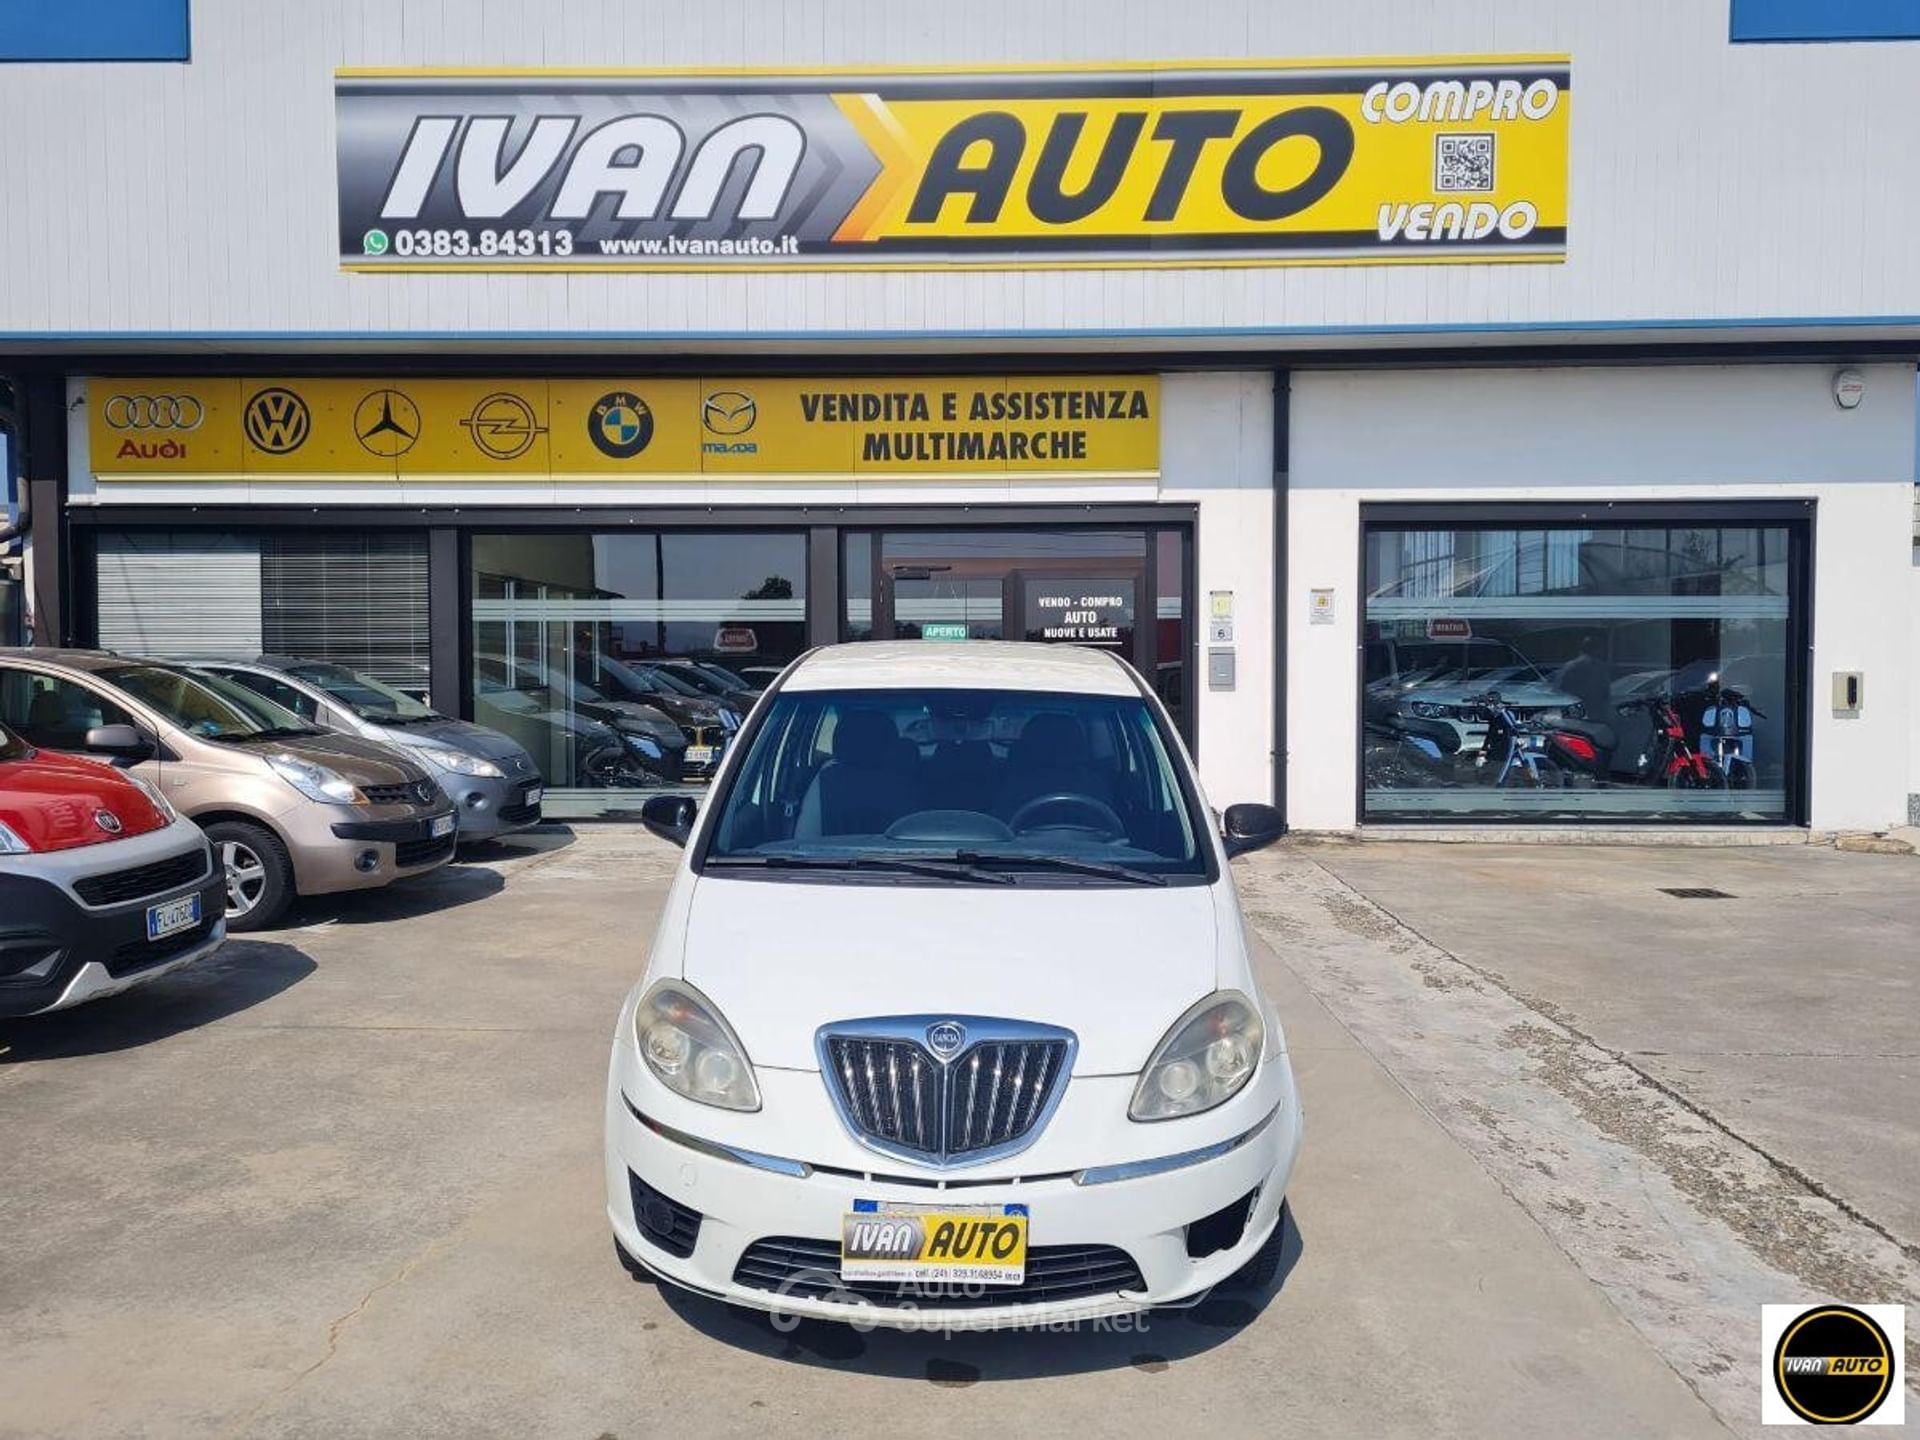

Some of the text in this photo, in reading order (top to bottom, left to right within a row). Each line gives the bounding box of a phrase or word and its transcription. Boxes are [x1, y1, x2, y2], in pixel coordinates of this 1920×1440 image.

[1361, 78, 1559, 123] COMPRO
[380, 105, 1355, 224] IVAN AUTO
[1376, 201, 1538, 241] VENDO
[395, 229, 573, 257] 0383.84313
[600, 235, 799, 256] www.ivanauto.it
[801, 390, 1149, 422] VENDITA E ASSISTENZA
[116, 439, 187, 459] Audi
[862, 431, 1087, 461] MULTIMARCHE
[1039, 596, 1071, 607] VENDO
[1081, 596, 1123, 607] COMPRO
[1064, 611, 1098, 624] AUTO
[926, 627, 966, 637] APERTO
[1044, 627, 1118, 638] NUOVE E USATE
[851, 1221, 1020, 1261] IVAN AUTO
